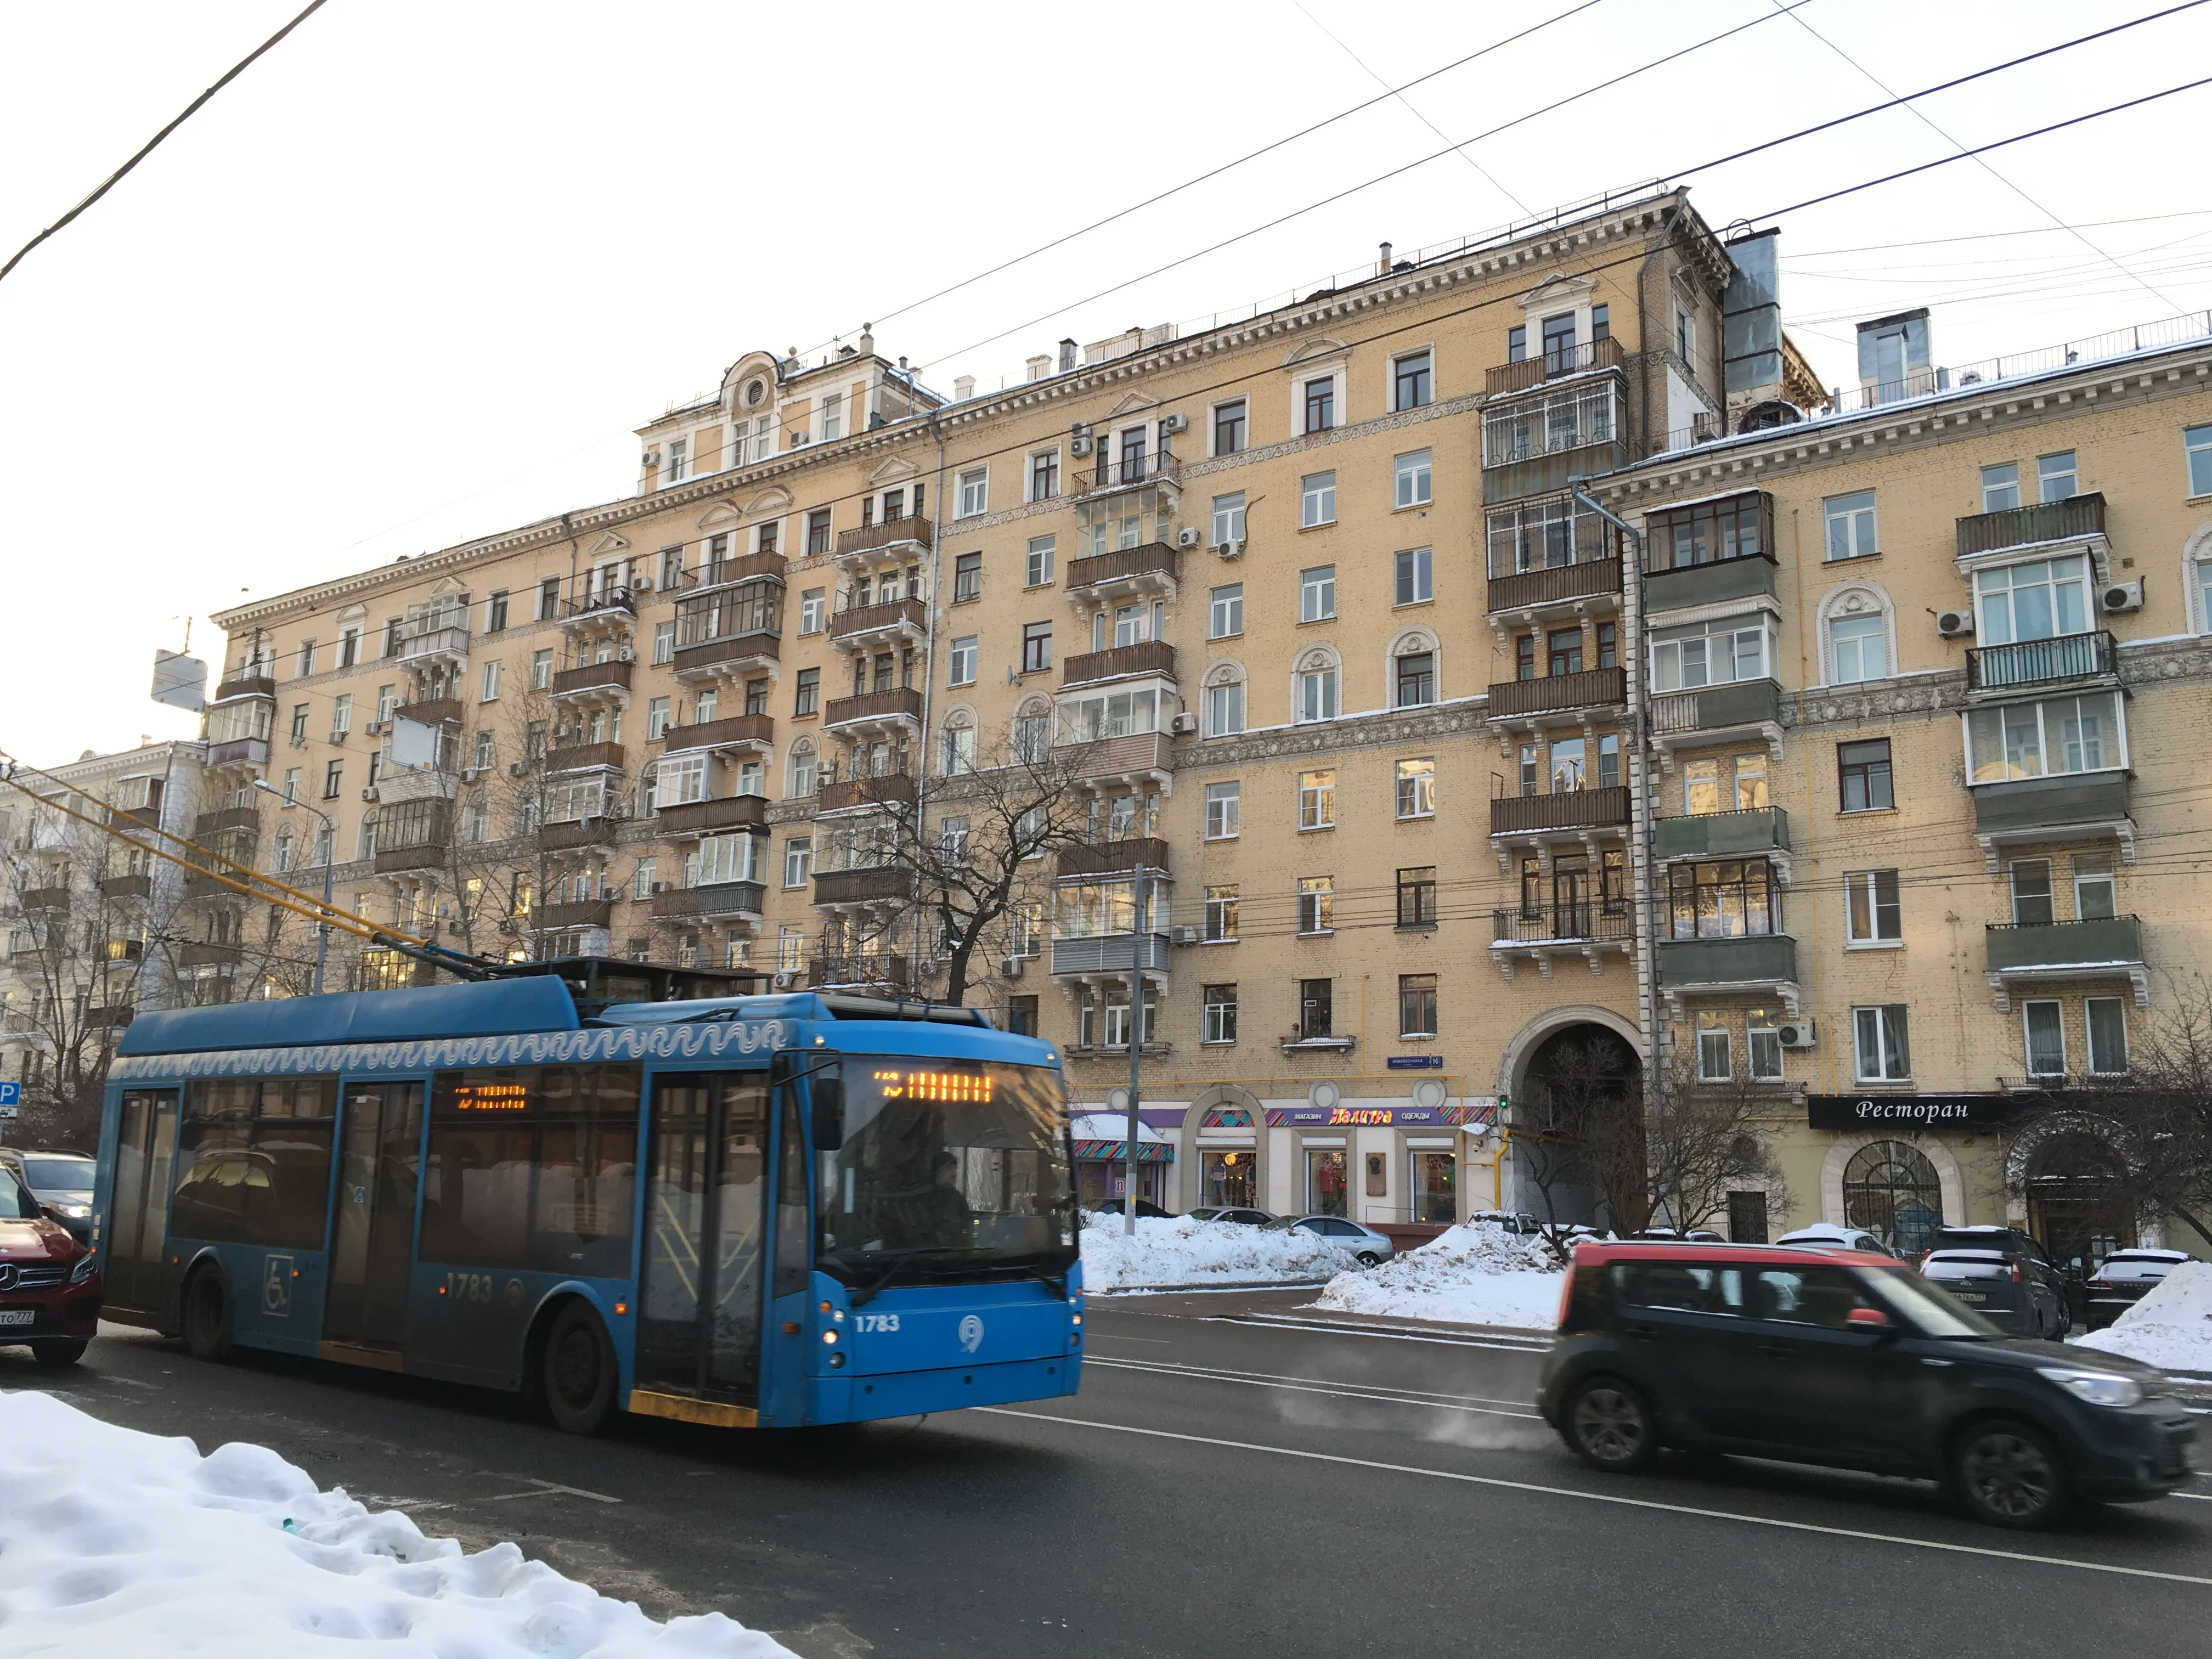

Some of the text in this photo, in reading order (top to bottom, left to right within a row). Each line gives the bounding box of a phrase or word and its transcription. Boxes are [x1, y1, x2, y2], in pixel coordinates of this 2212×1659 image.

[1, 1084, 15, 1102] P
[1856, 1101, 1968, 1124] Ресторан
[447, 1272, 492, 1303] 1783
[16, 1312, 32, 1320] 777
[855, 1314, 900, 1332] 1783
